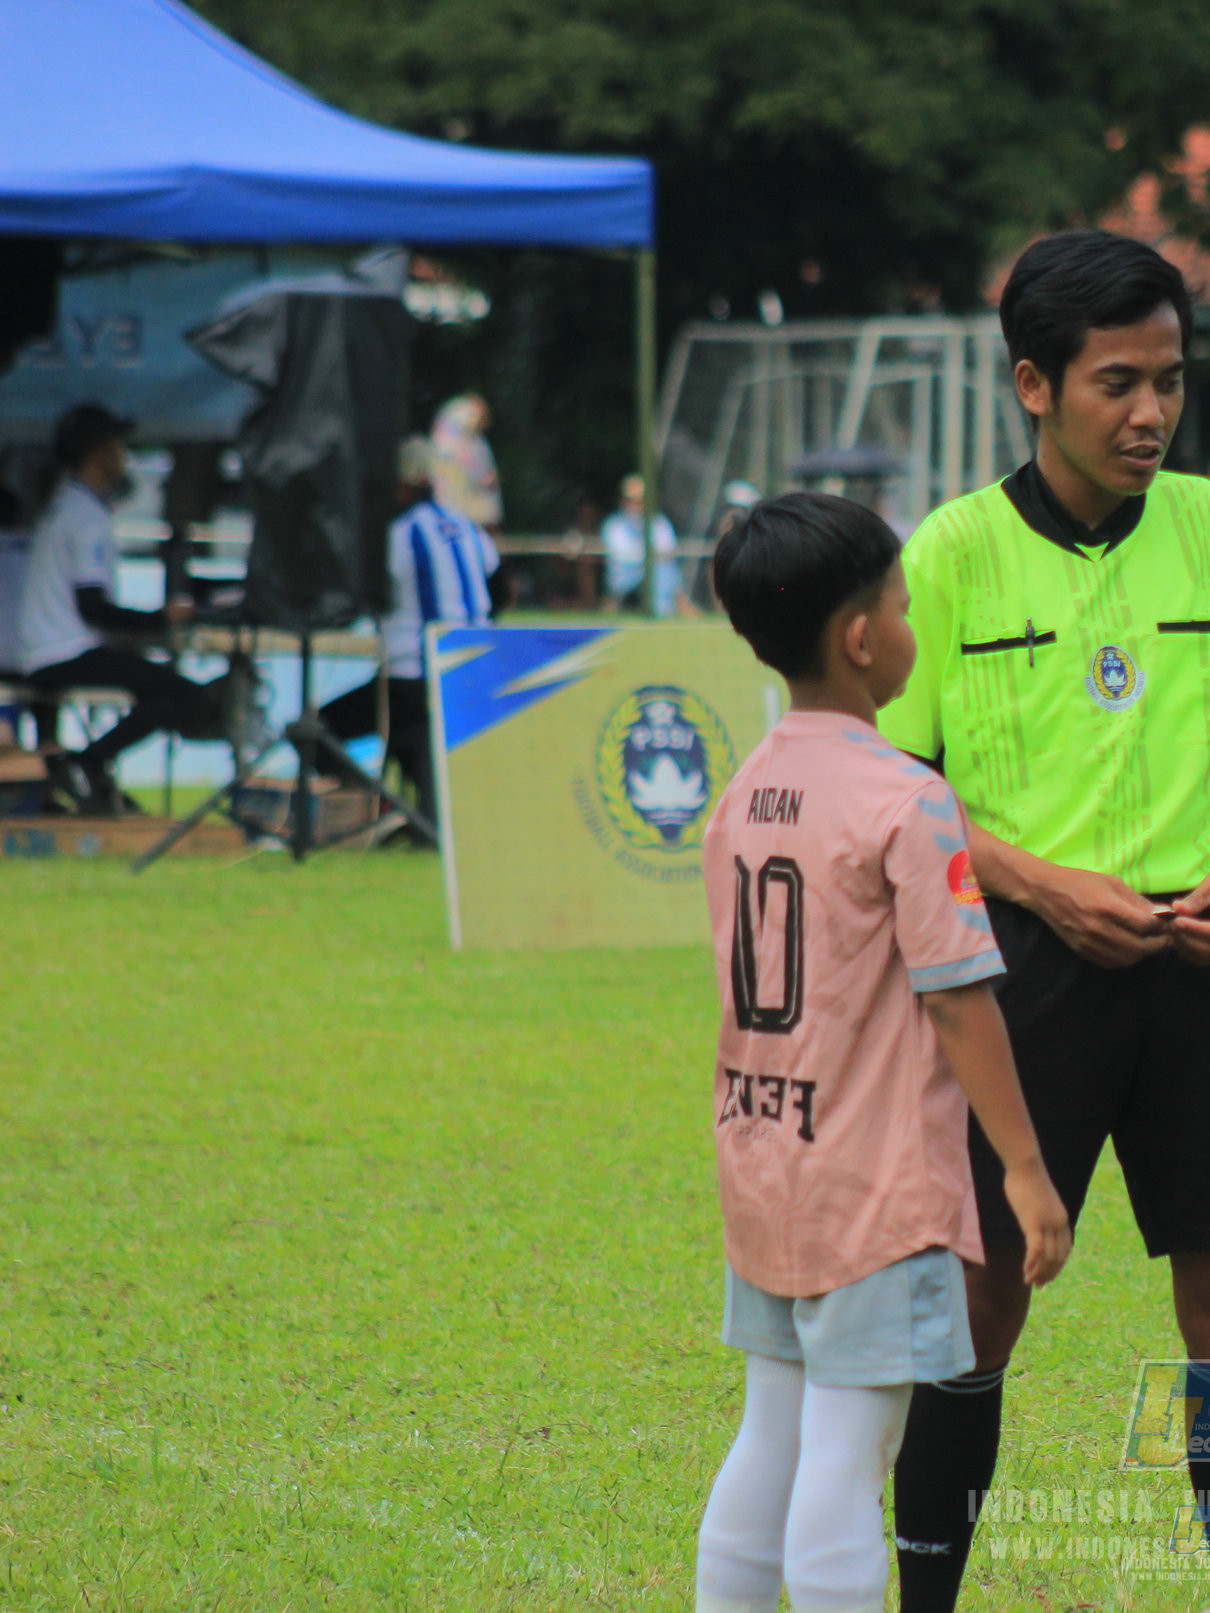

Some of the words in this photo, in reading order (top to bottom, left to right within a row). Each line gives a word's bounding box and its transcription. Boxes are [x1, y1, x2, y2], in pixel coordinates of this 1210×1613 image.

[629, 723, 696, 751] PSSI
[746, 787, 805, 826] AIDAN
[731, 854, 805, 1035] 10
